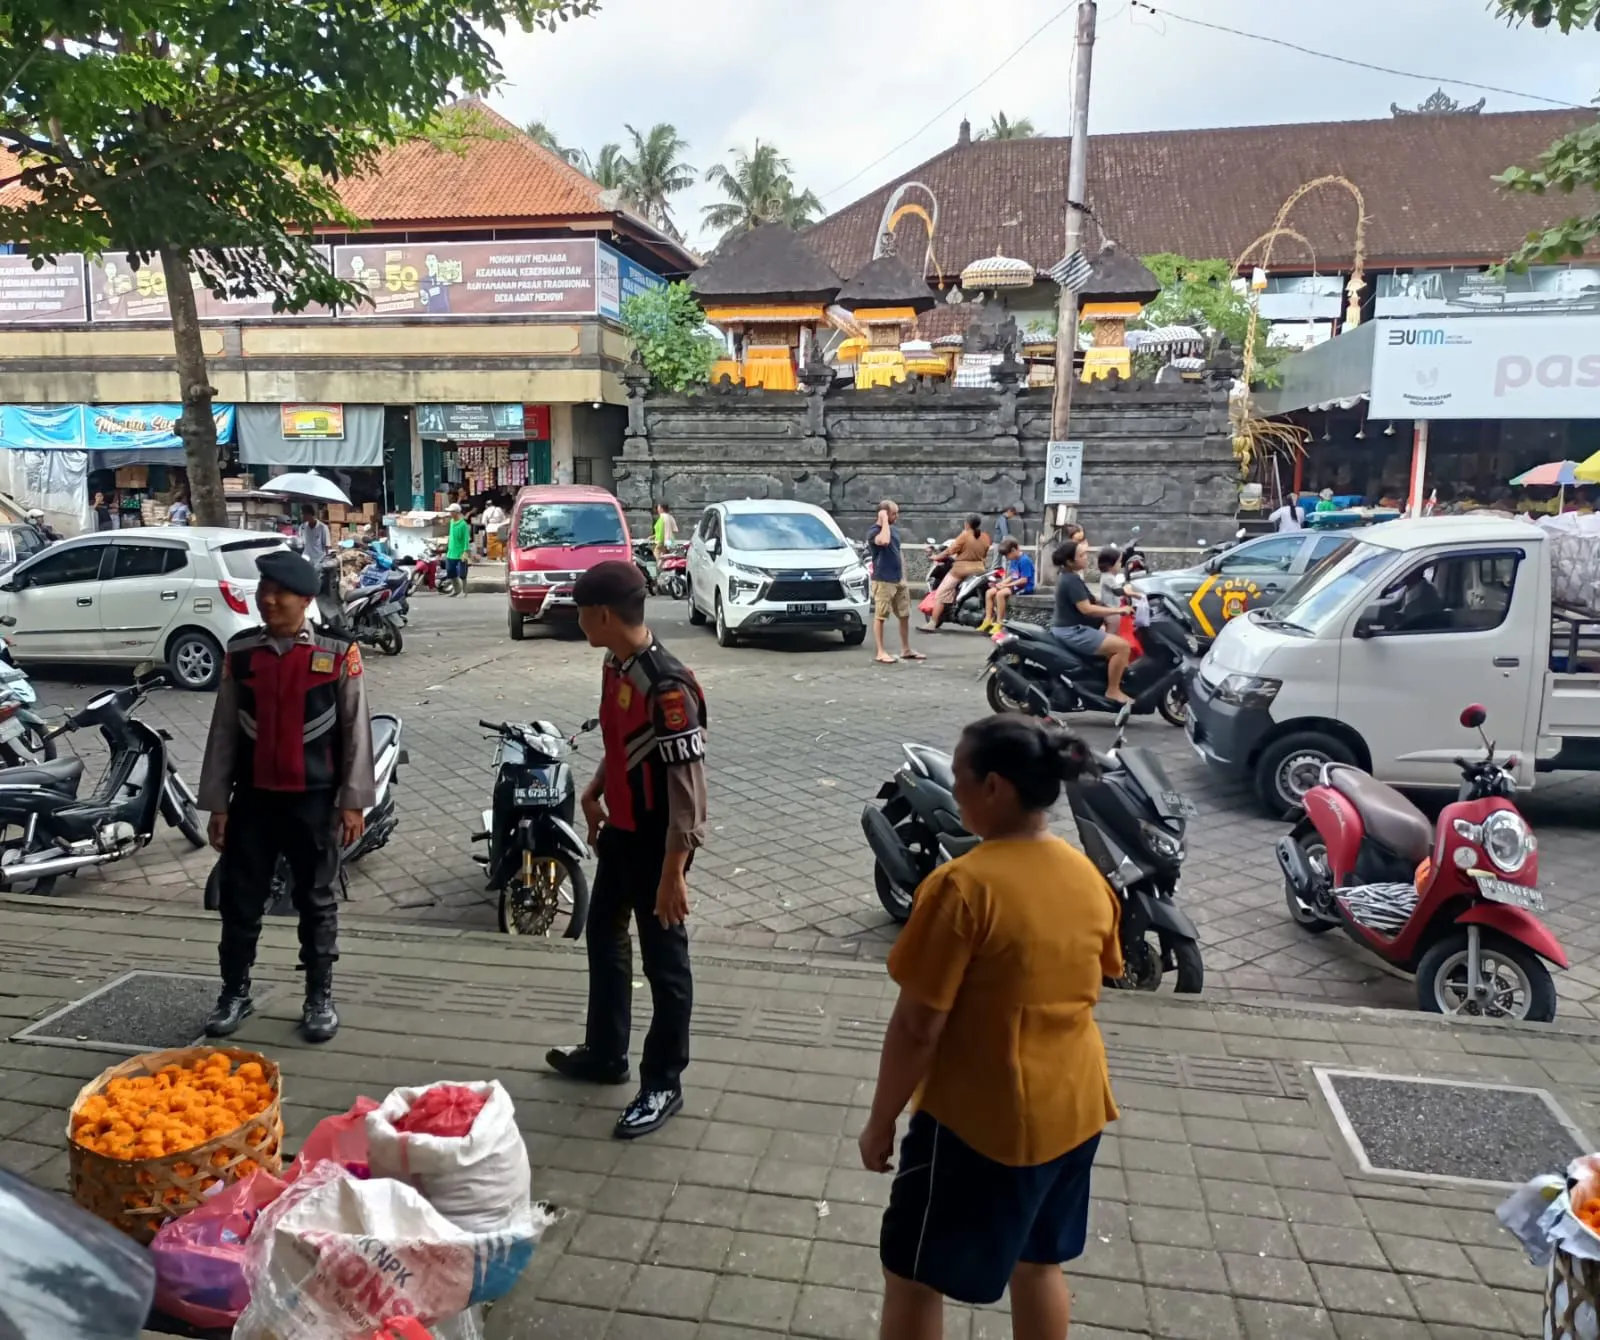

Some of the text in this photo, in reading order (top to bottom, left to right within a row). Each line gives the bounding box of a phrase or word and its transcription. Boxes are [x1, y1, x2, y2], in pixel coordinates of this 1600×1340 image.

[489, 253, 567, 264] MOHON IKUT MENJAGA
[520, 266, 565, 276] KEBERSIHAN
[566, 266, 582, 276] DAN
[543, 279, 591, 289] TRADISIONAL
[1388, 329, 1445, 345] BUMN
[1215, 576, 1263, 599] POLISI
